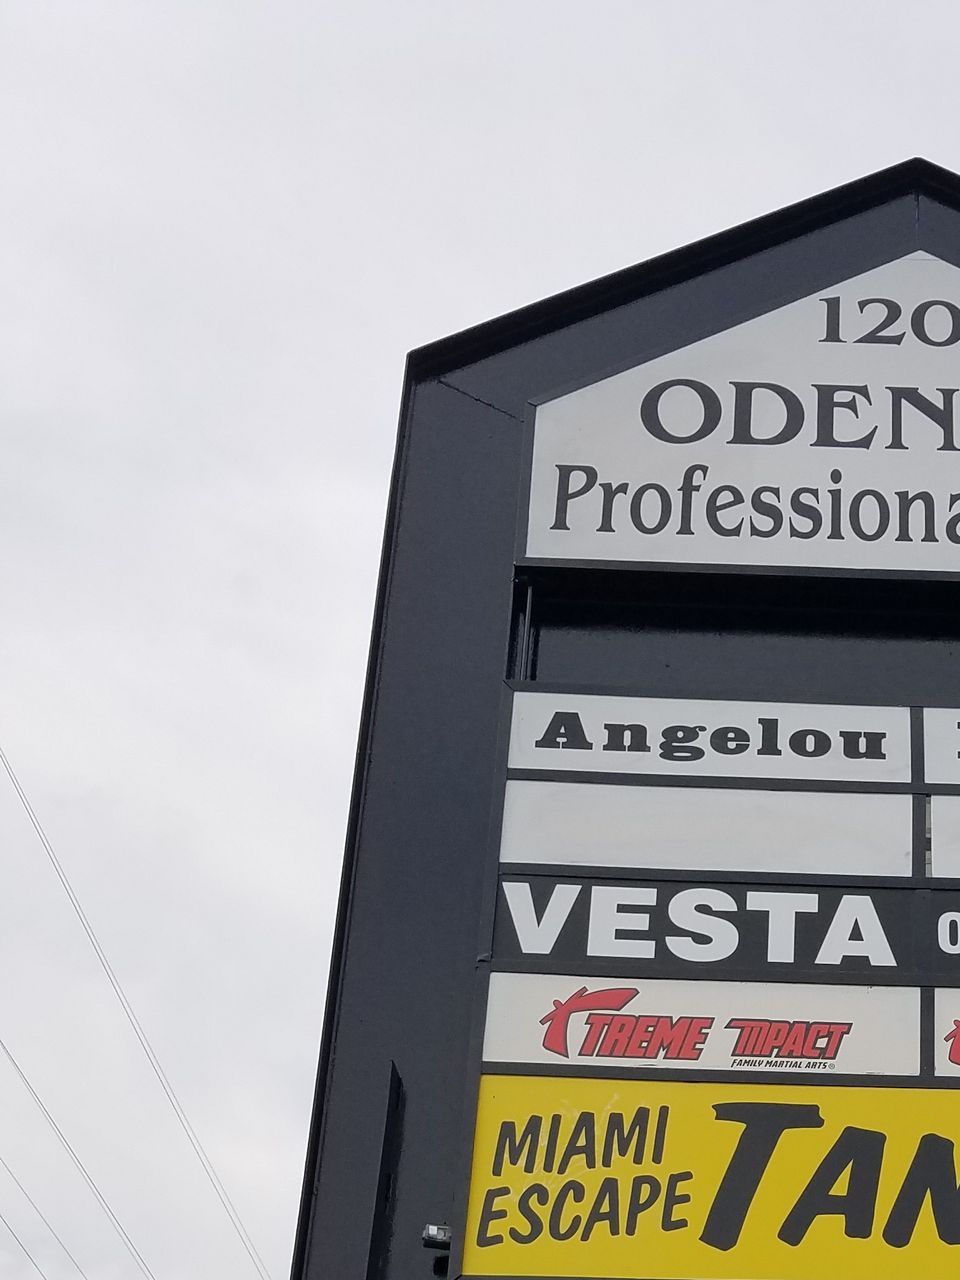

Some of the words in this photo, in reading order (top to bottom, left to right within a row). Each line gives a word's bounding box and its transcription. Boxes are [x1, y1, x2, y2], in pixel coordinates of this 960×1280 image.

[534, 711, 887, 762] Angelou
[501, 881, 898, 967] VESTA
[731, 1059, 763, 1068] FAMILY
[765, 1060, 802, 1069] MARTIAL
[491, 1105, 670, 1177] MIAMI
[476, 1171, 694, 1248] ESCAPE
